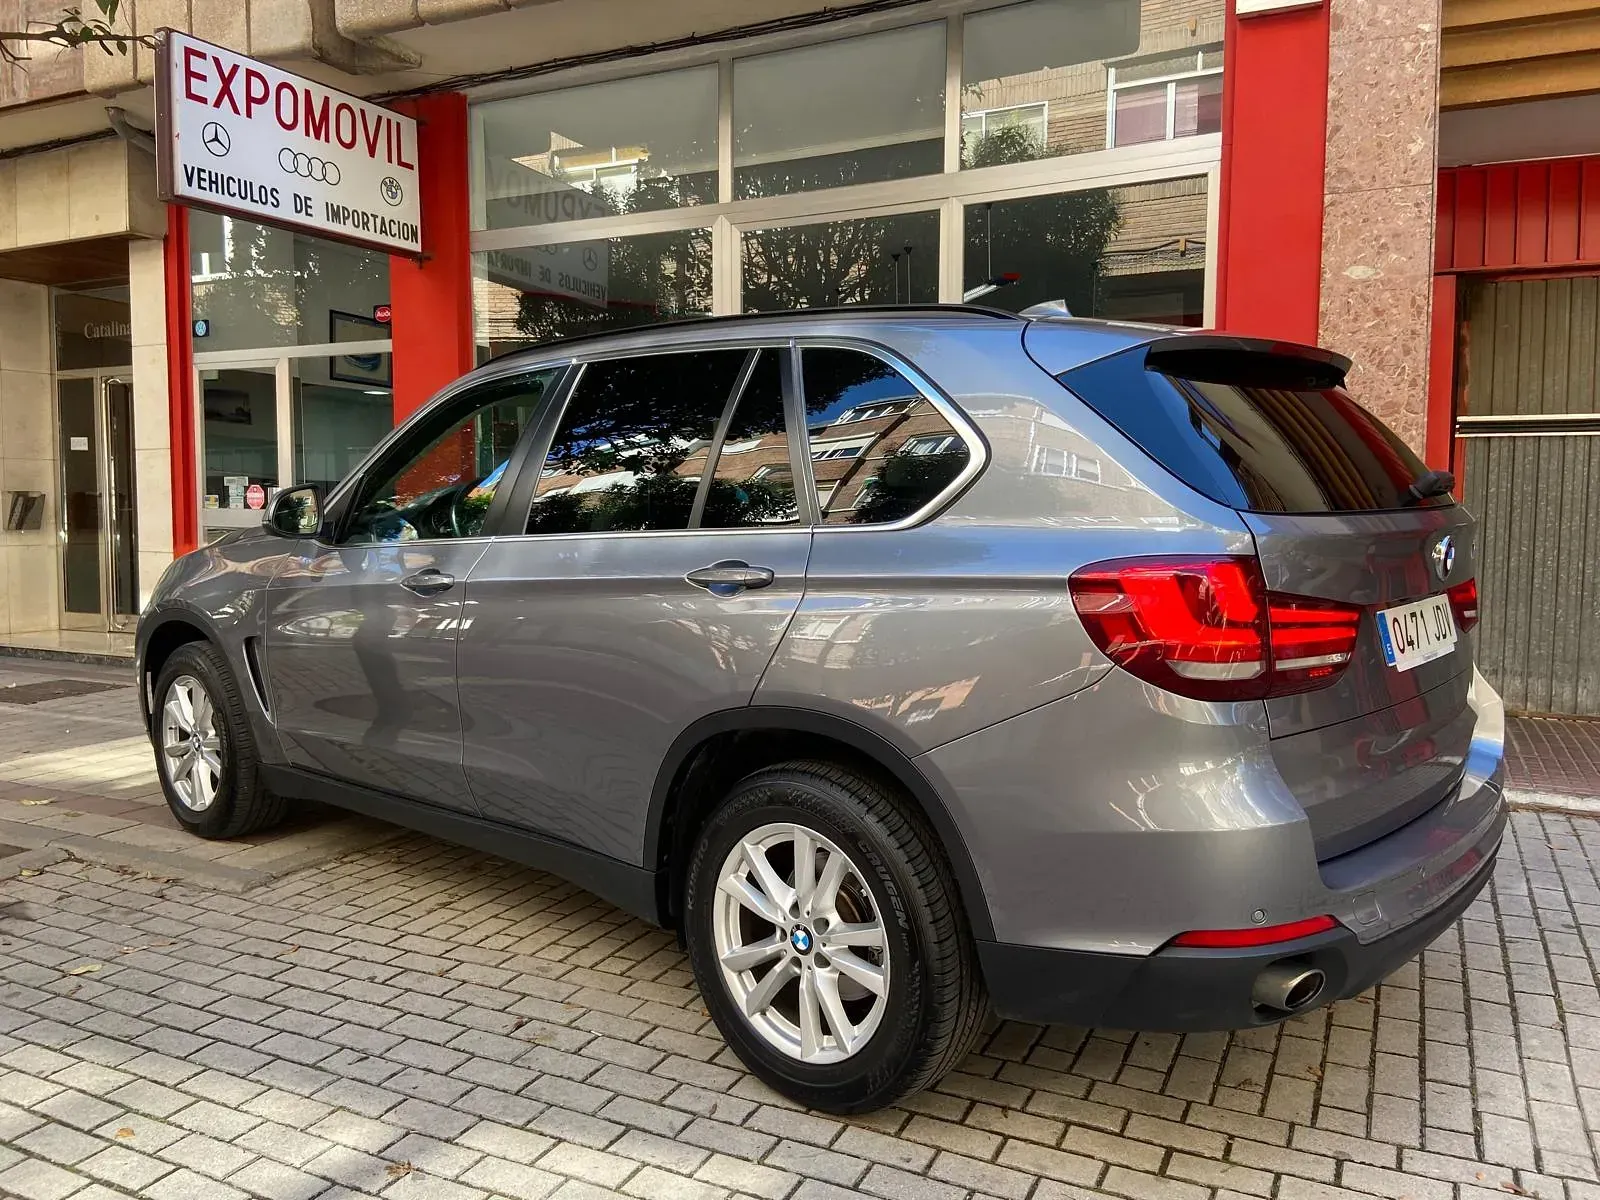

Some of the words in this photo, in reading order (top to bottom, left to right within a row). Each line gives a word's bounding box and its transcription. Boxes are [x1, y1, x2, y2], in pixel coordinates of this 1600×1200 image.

[184, 46, 414, 171] EXPOMOVIL
[184, 164, 280, 208] VEHICULOS
[293, 193, 314, 217] DE
[325, 201, 419, 244] IMPORTACION
[1392, 609, 1431, 654] 0471
[1432, 602, 1452, 642] JDV
